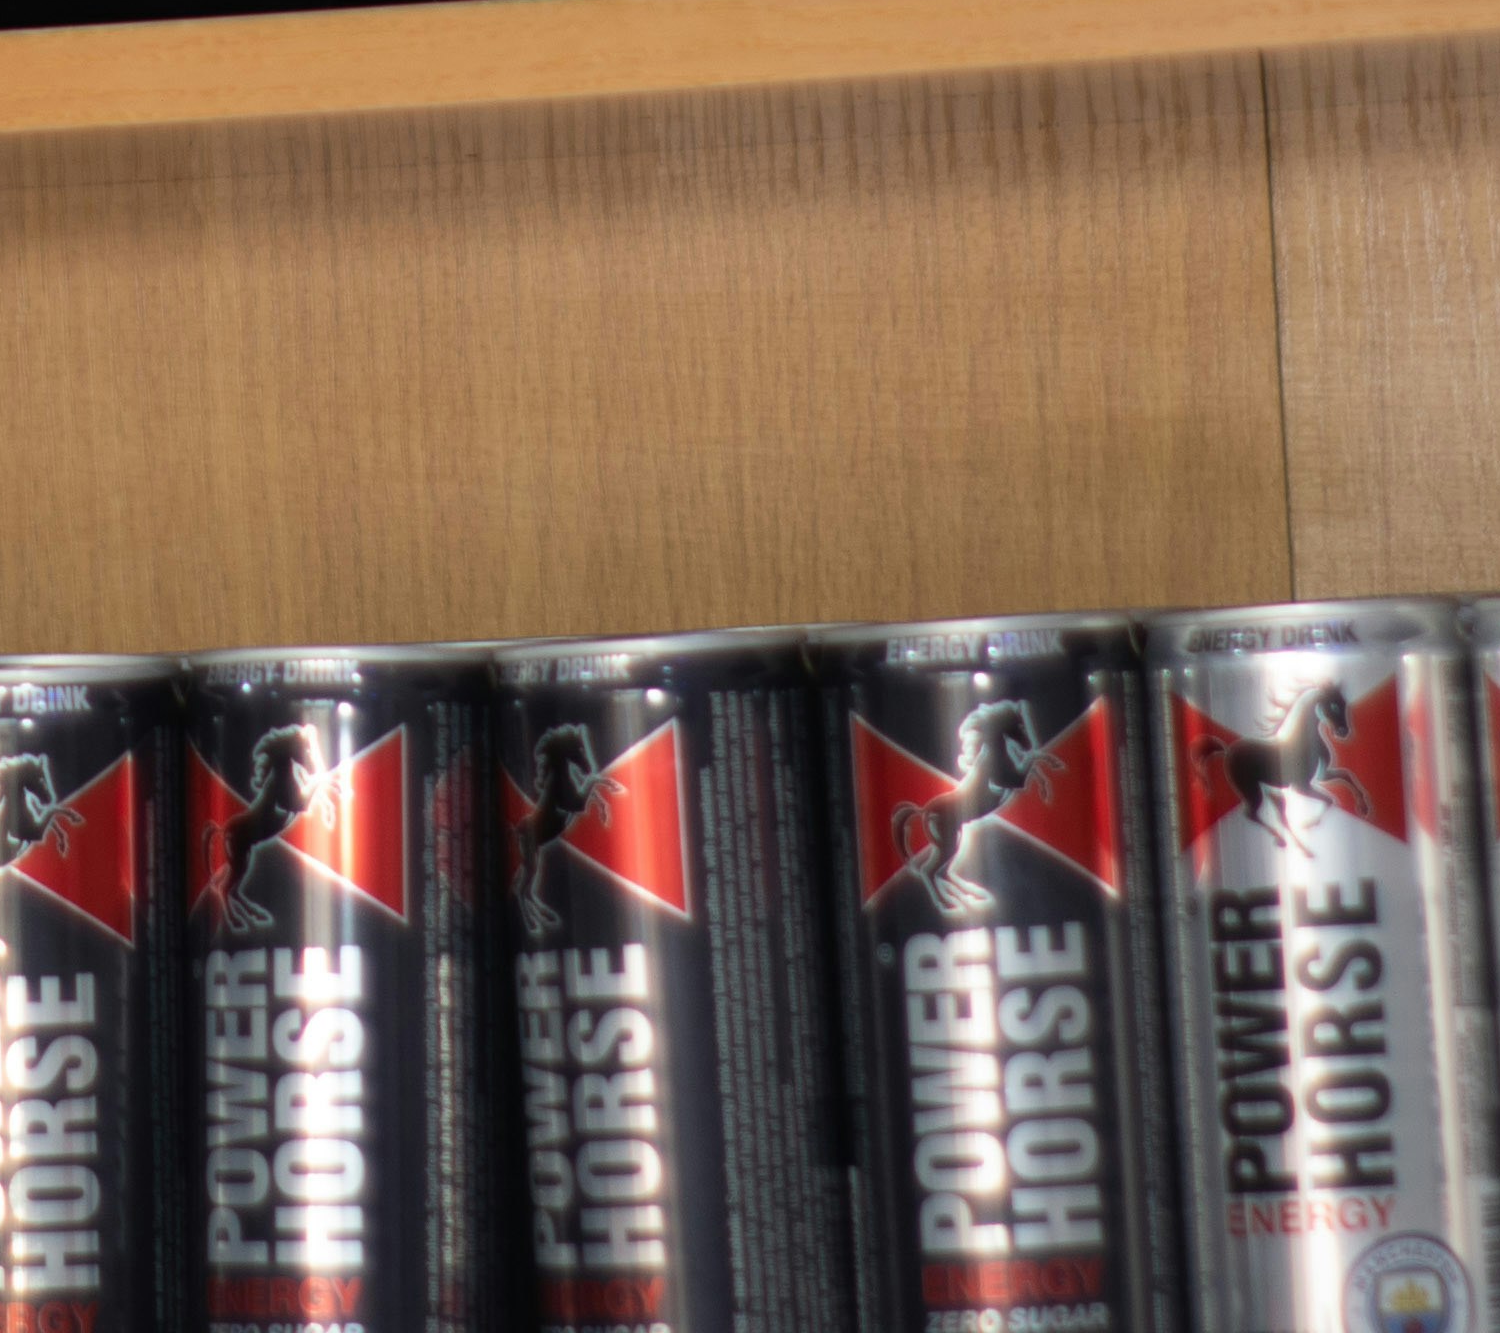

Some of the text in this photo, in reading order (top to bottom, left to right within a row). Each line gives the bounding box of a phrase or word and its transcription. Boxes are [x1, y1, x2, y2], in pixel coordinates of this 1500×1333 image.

[12, 683, 91, 713] DRINK
[886, 630, 1066, 664] ENERGY DRINK
[1187, 621, 1358, 655] ENERGY DRINK
[5, 971, 99, 1292] HORSE
[206, 946, 269, 1268] POWER
[273, 944, 364, 1269] HORSE
[515, 949, 579, 1269] POWER
[562, 943, 666, 1269] HORSE
[904, 928, 1010, 1256] POWER
[994, 921, 1104, 1253] HORSE
[1209, 884, 1299, 1194] POWER
[1292, 876, 1396, 1189] HORSE
